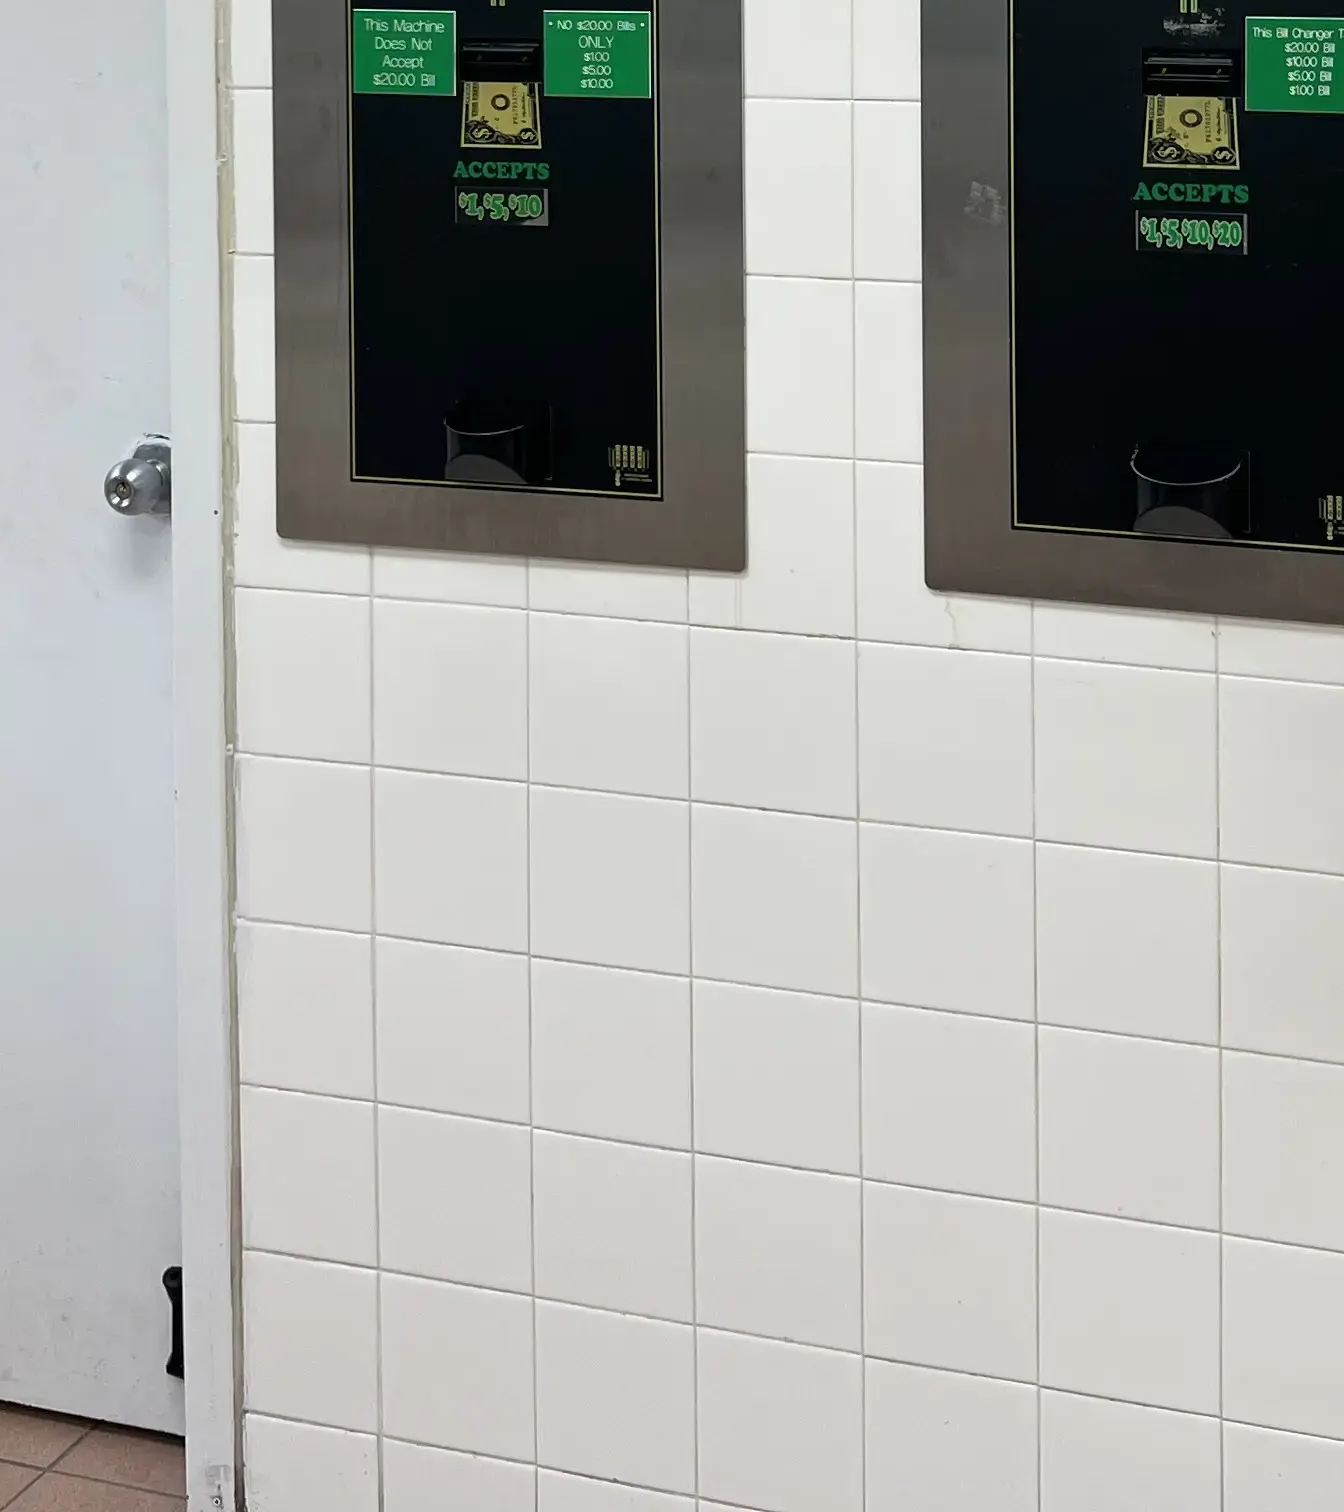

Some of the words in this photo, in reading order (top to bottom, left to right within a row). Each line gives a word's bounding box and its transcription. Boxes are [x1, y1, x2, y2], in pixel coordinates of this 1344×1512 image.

[364, 18, 390, 32] This
[393, 19, 445, 34] Machine
[557, 20, 572, 31] NO
[576, 20, 613, 31] $20.00
[616, 20, 636, 32] Bills
[1252, 26, 1272, 38] This
[1276, 27, 1288, 38] Bill
[1291, 27, 1334, 41] Changer
[374, 36, 406, 51] Does
[411, 38, 433, 51] Not
[578, 36, 614, 49] ONLY
[1284, 42, 1319, 53] $20.00
[1323, 43, 1336, 53] Bill
[382, 54, 424, 70] Accept
[583, 51, 610, 63] $1.00
[1286, 56, 1317, 67] $10.00
[1321, 56, 1334, 67] Bill
[582, 64, 611, 76] $5.00
[1287, 70, 1316, 81] $5.00
[1319, 71, 1332, 81] Bill
[373, 73, 416, 87] $20.00
[420, 73, 436, 87] Bill
[580, 77, 613, 89] $10.00
[1289, 85, 1314, 96] $1.00
[1317, 85, 1330, 96] Bill
[452, 160, 550, 180] ACCEPTS
[1133, 181, 1249, 203] ACCEPTS
